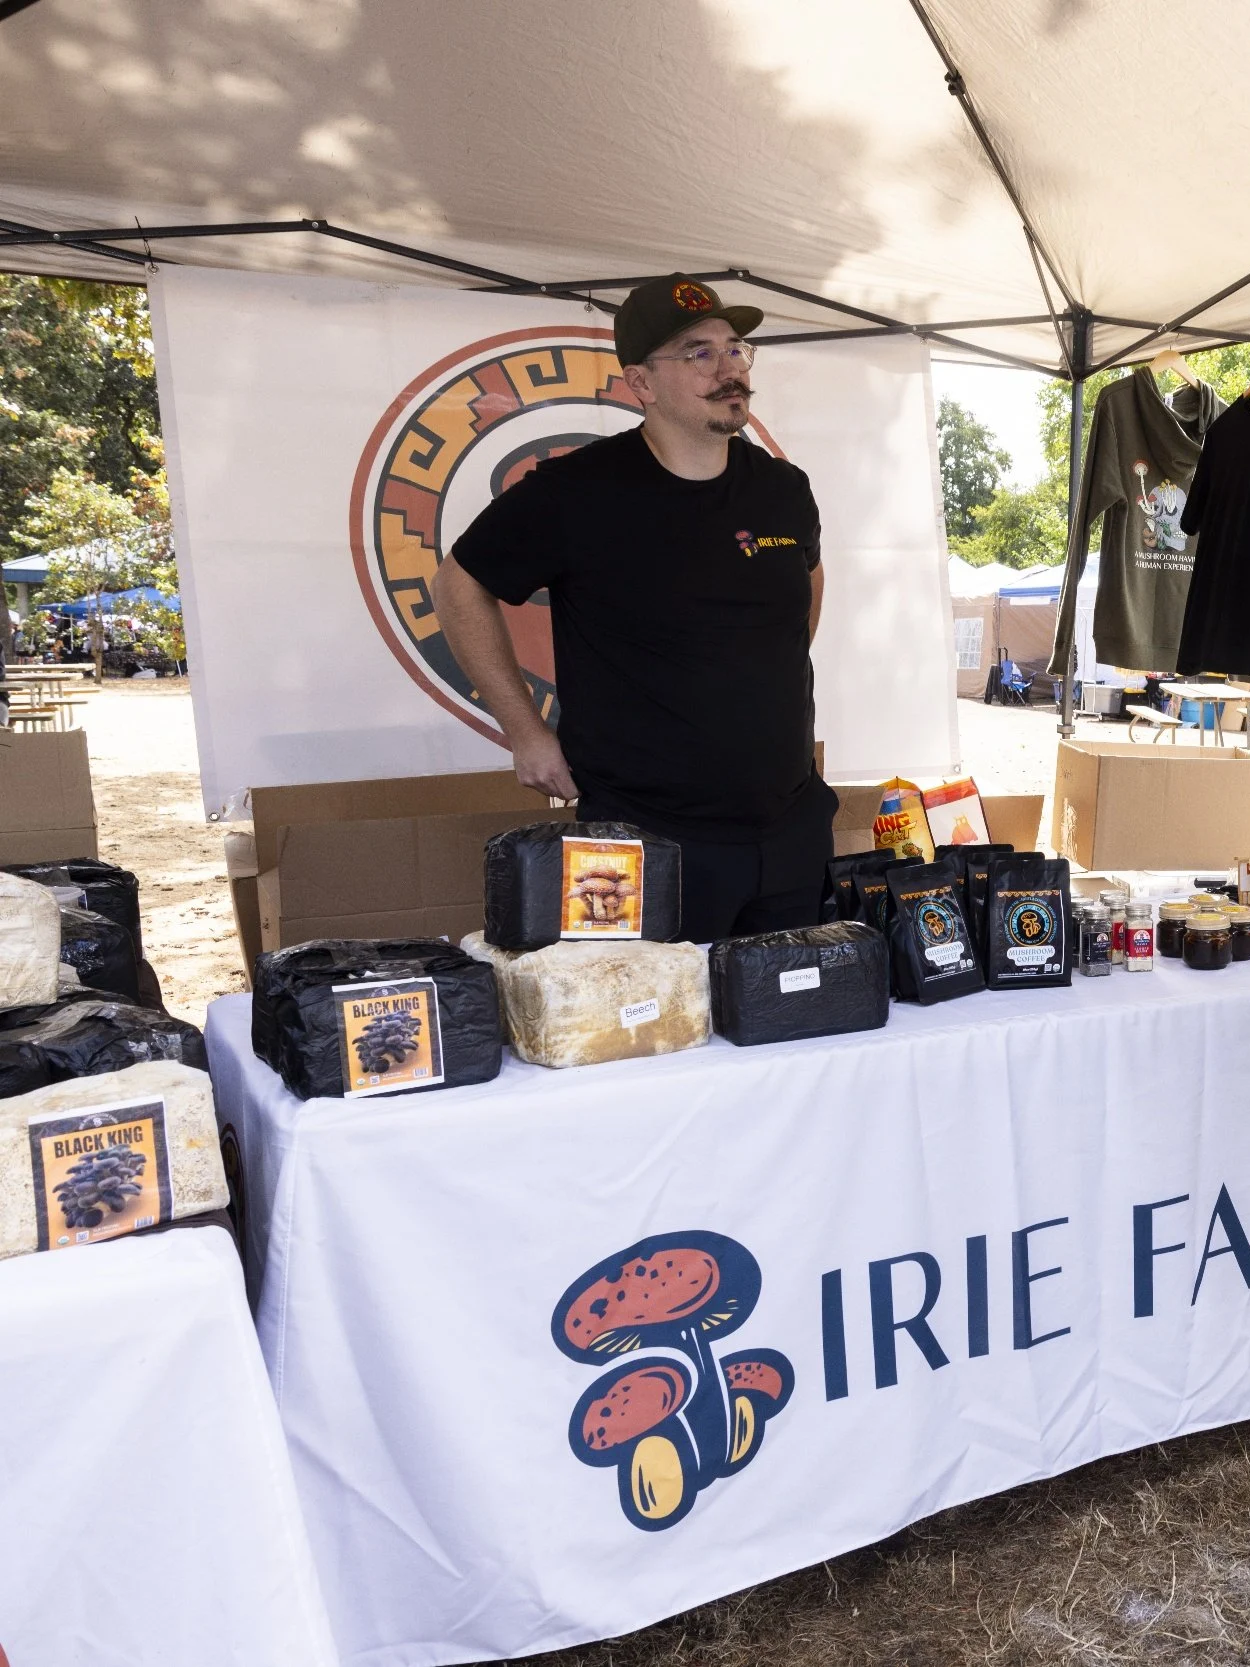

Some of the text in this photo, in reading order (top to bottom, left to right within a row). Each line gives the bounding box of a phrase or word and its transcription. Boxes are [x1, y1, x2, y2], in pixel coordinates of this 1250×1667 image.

[757, 537, 797, 547] IRIE FARM
[1139, 552, 1178, 562] MUSHROOM
[1139, 561, 1162, 570] HUMAN
[580, 855, 628, 869] CHESTNUT
[926, 944, 963, 957] MUSHROOM
[1008, 947, 1054, 957] MUSHROOM
[936, 953, 958, 963] COFFEE
[1016, 955, 1046, 963] COFFEE
[784, 973, 816, 984] PIOPPINO
[352, 996, 420, 1019] BLACK KING
[625, 1002, 656, 1018] Beech
[54, 1125, 143, 1159] BLACK KING
[821, 1216, 1071, 1404] IRIE
